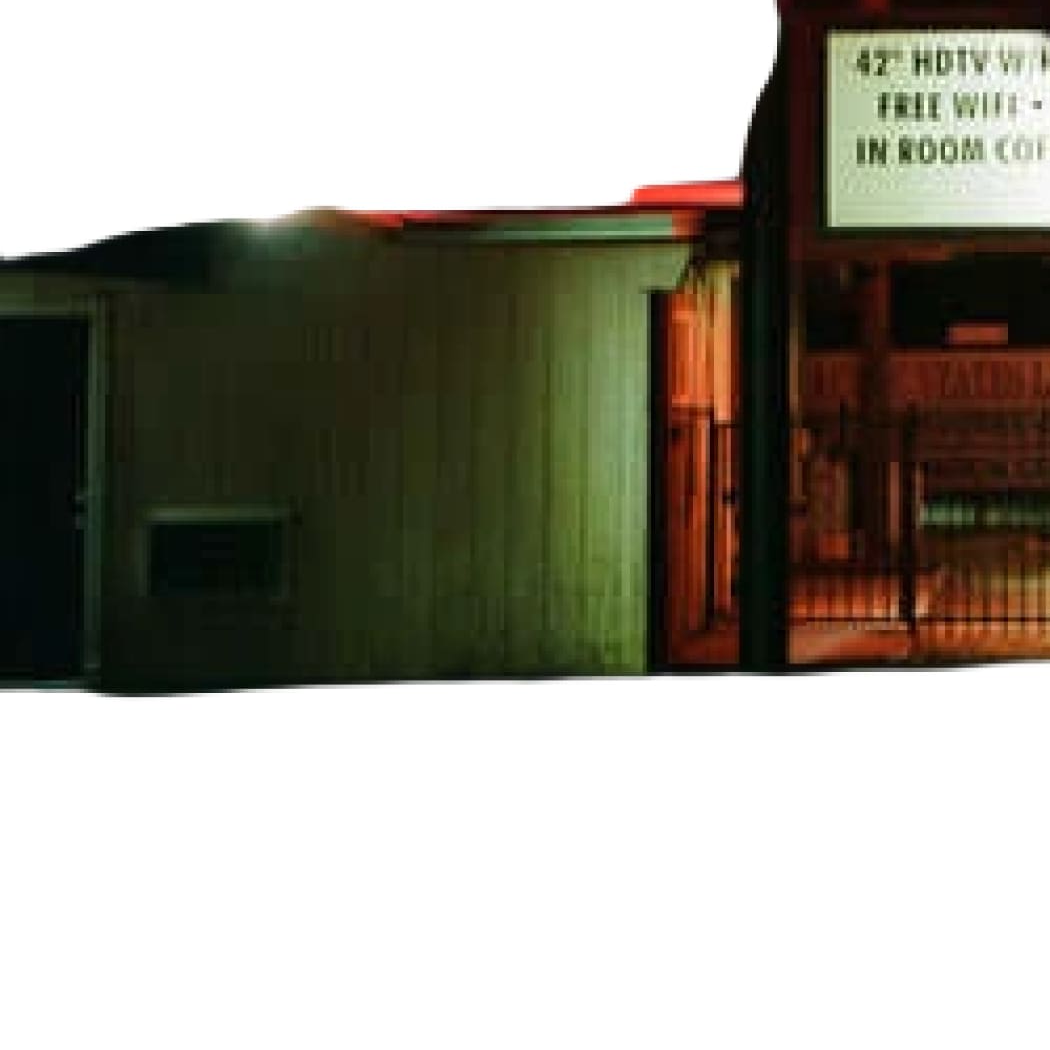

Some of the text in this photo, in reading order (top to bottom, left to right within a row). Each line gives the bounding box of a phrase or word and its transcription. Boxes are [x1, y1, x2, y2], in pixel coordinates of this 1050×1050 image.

[911, 46, 987, 76] HDTV
[877, 91, 942, 121] FREE
[856, 135, 888, 165] IN
[898, 135, 984, 165] ROOM
